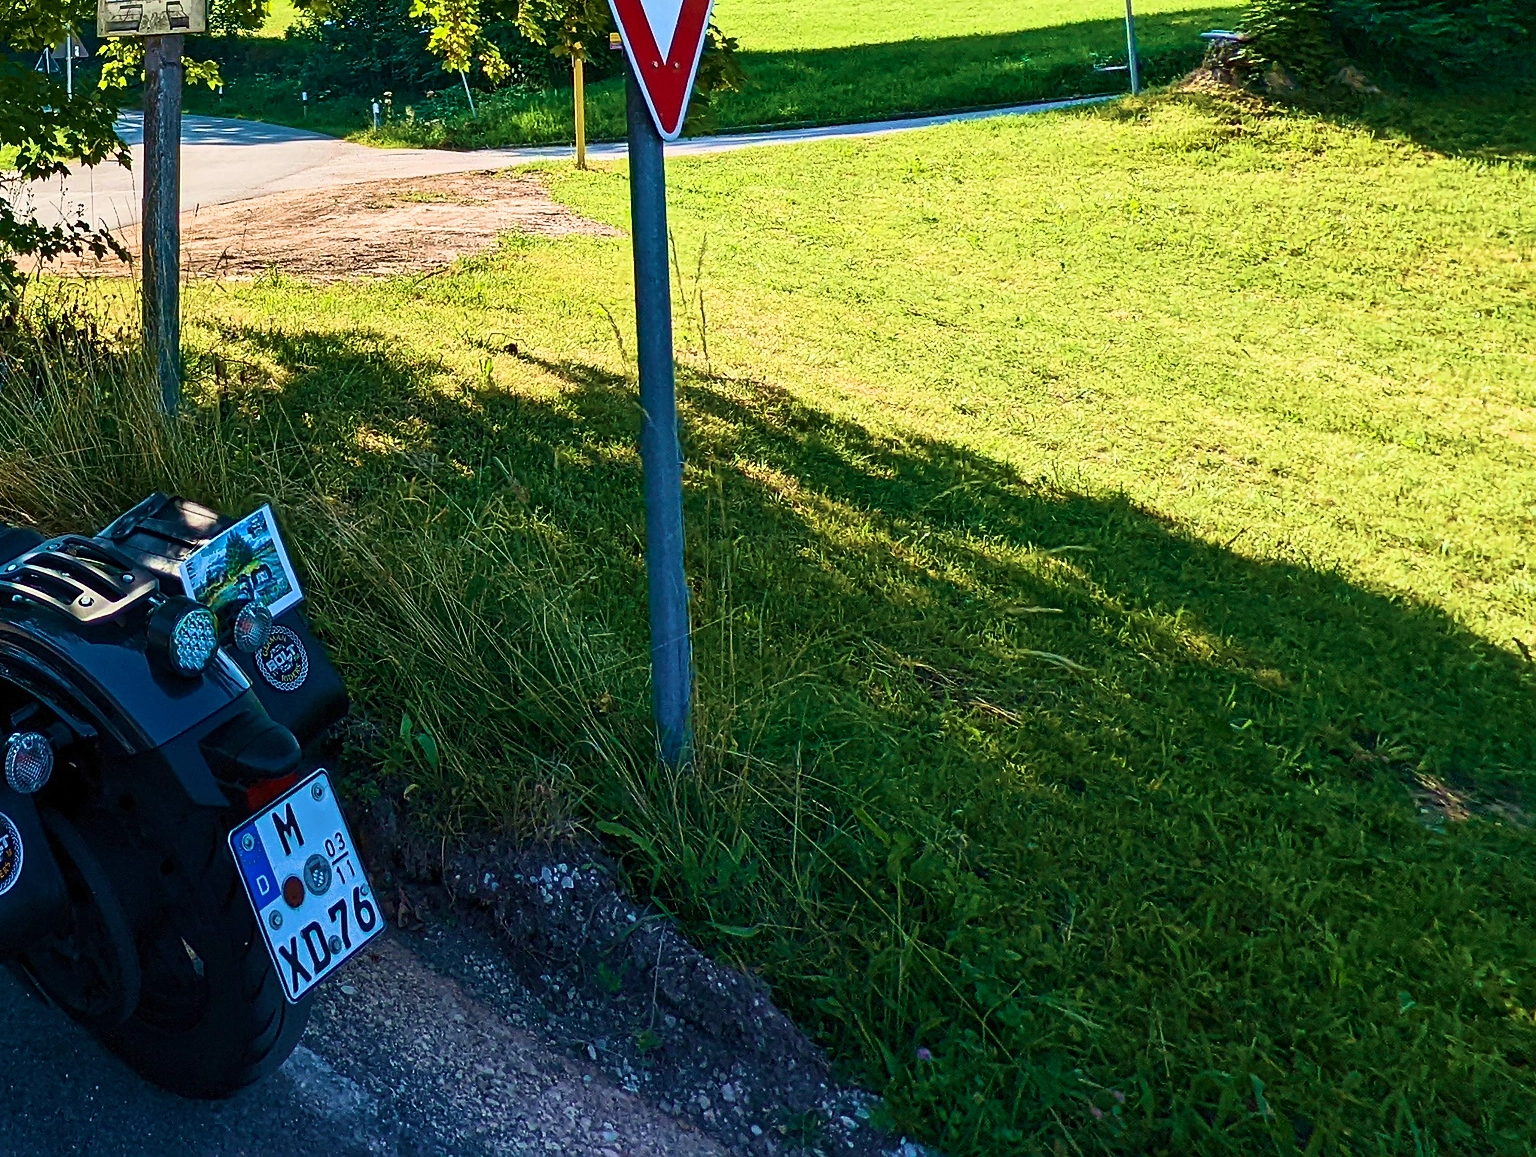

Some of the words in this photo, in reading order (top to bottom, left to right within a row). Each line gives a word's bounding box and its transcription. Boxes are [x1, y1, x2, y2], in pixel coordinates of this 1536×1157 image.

[265, 644, 296, 672] BOLT
[271, 802, 305, 857] M
[324, 831, 346, 858] 03
[255, 874, 270, 896] D
[336, 859, 356, 885] 11
